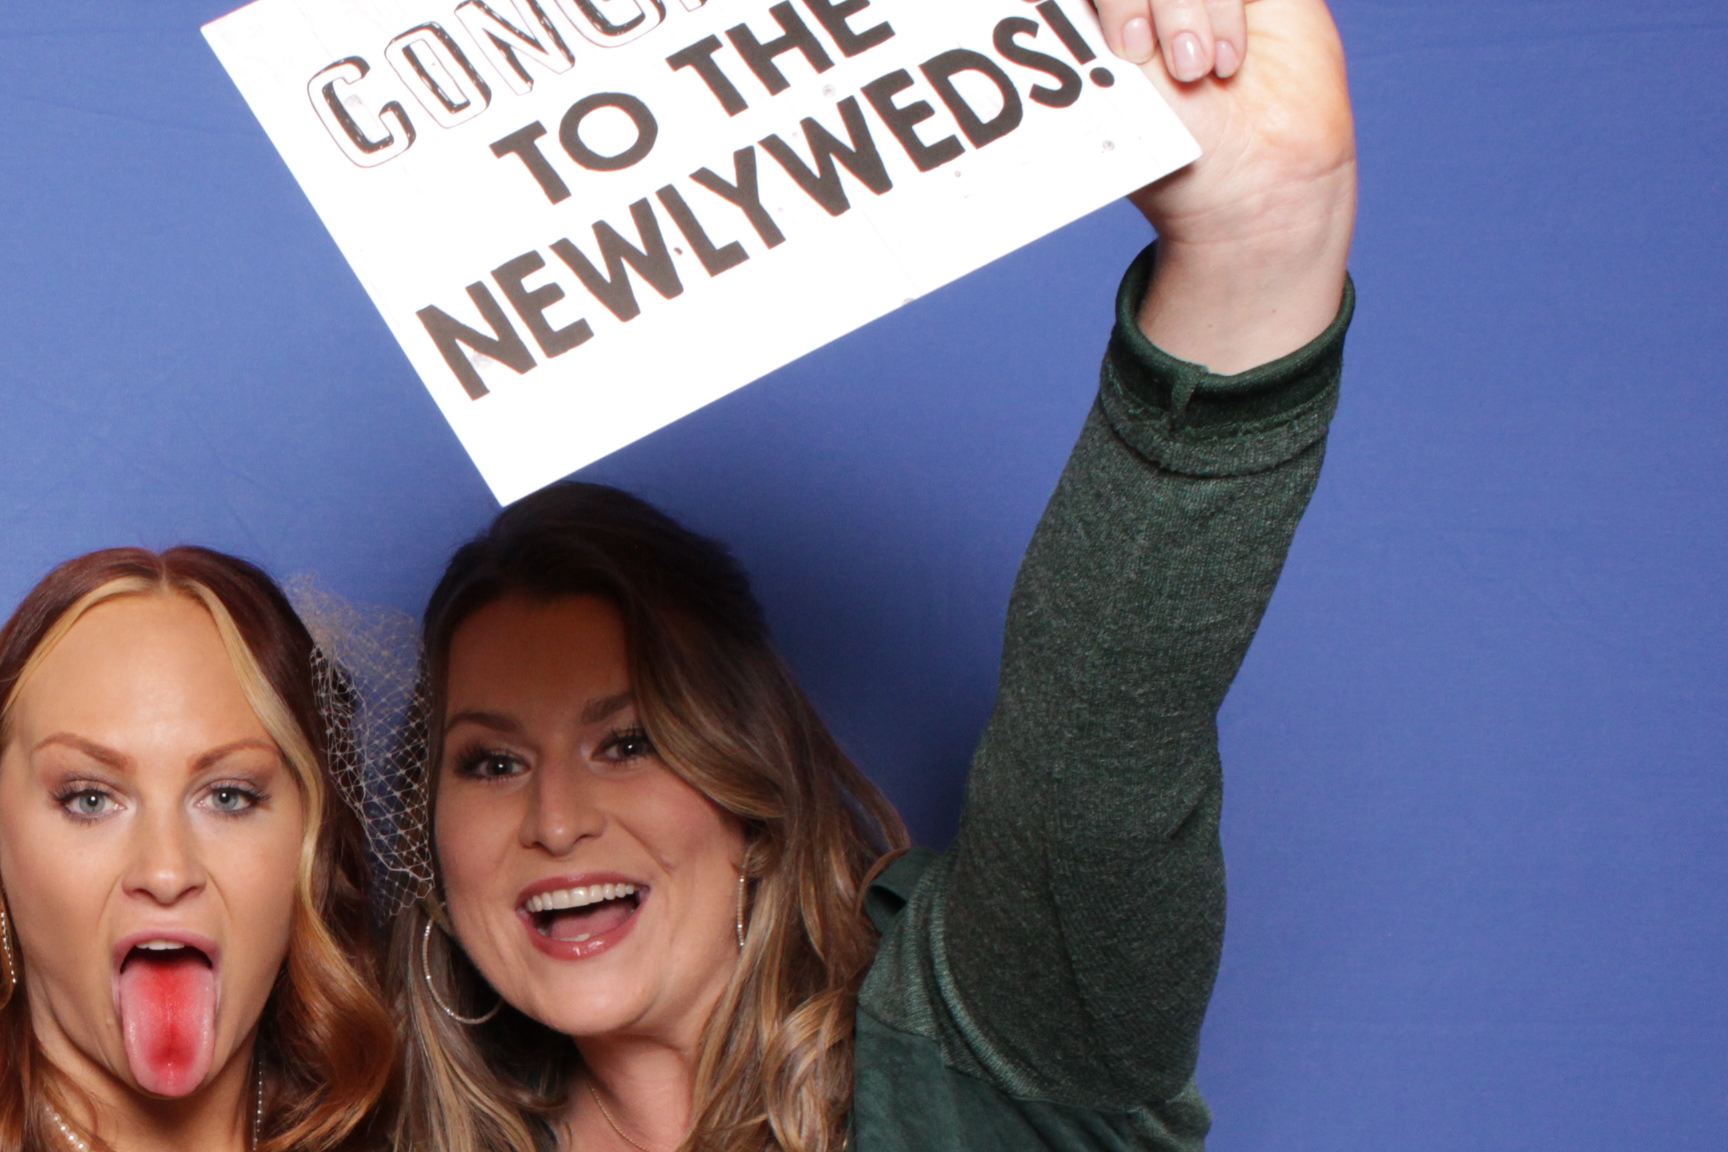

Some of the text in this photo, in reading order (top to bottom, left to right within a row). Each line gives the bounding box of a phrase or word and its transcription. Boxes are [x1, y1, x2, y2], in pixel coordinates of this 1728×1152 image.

[415, 0, 1115, 401] NEWLYWEDS!
[489, 0, 896, 205] TO THE
